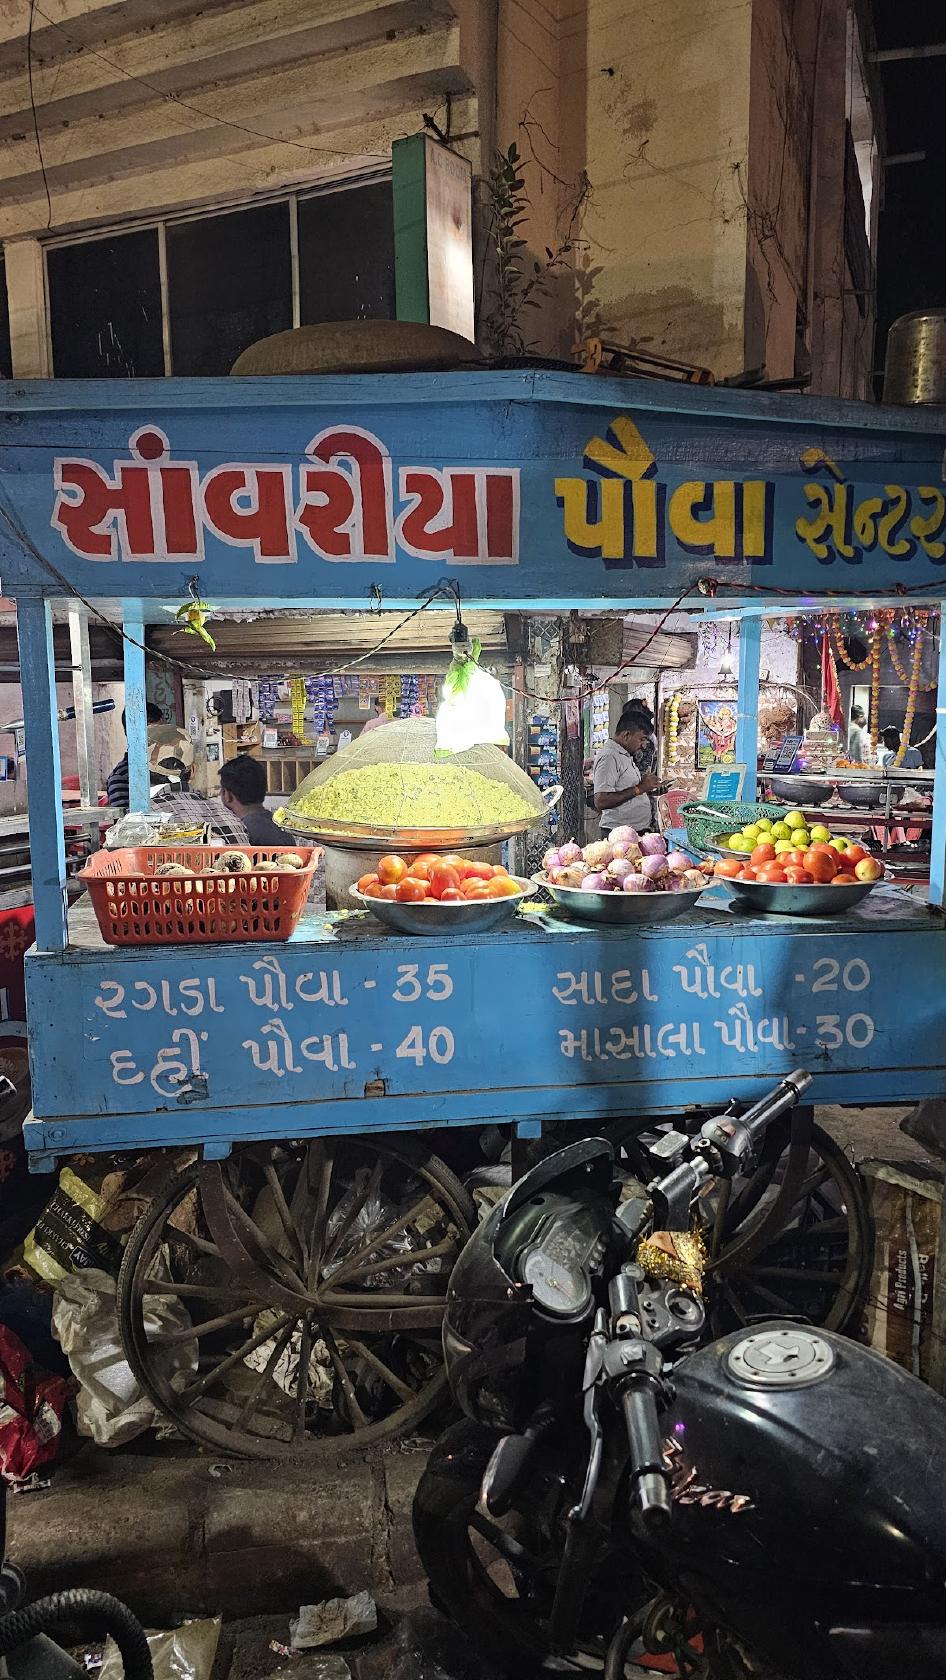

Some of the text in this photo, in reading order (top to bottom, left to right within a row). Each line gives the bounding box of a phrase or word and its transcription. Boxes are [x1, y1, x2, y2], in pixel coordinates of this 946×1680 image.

[50, 424, 521, 564] સાંવરીયા
[555, 415, 775, 569] પૌવા
[95, 976, 225, 1019] રગડા
[240, 955, 349, 1013] પૌવા
[391, 963, 454, 1003] 35
[551, 968, 659, 1006] સાદા
[673, 943, 764, 1000] પૌવા
[110, 1028, 209, 1098] દહીં
[241, 1017, 357, 1078] પૌવા
[395, 1025, 456, 1067] 40
[558, 1021, 706, 1062] માસાલા
[713, 1001, 796, 1054] પૌવા
